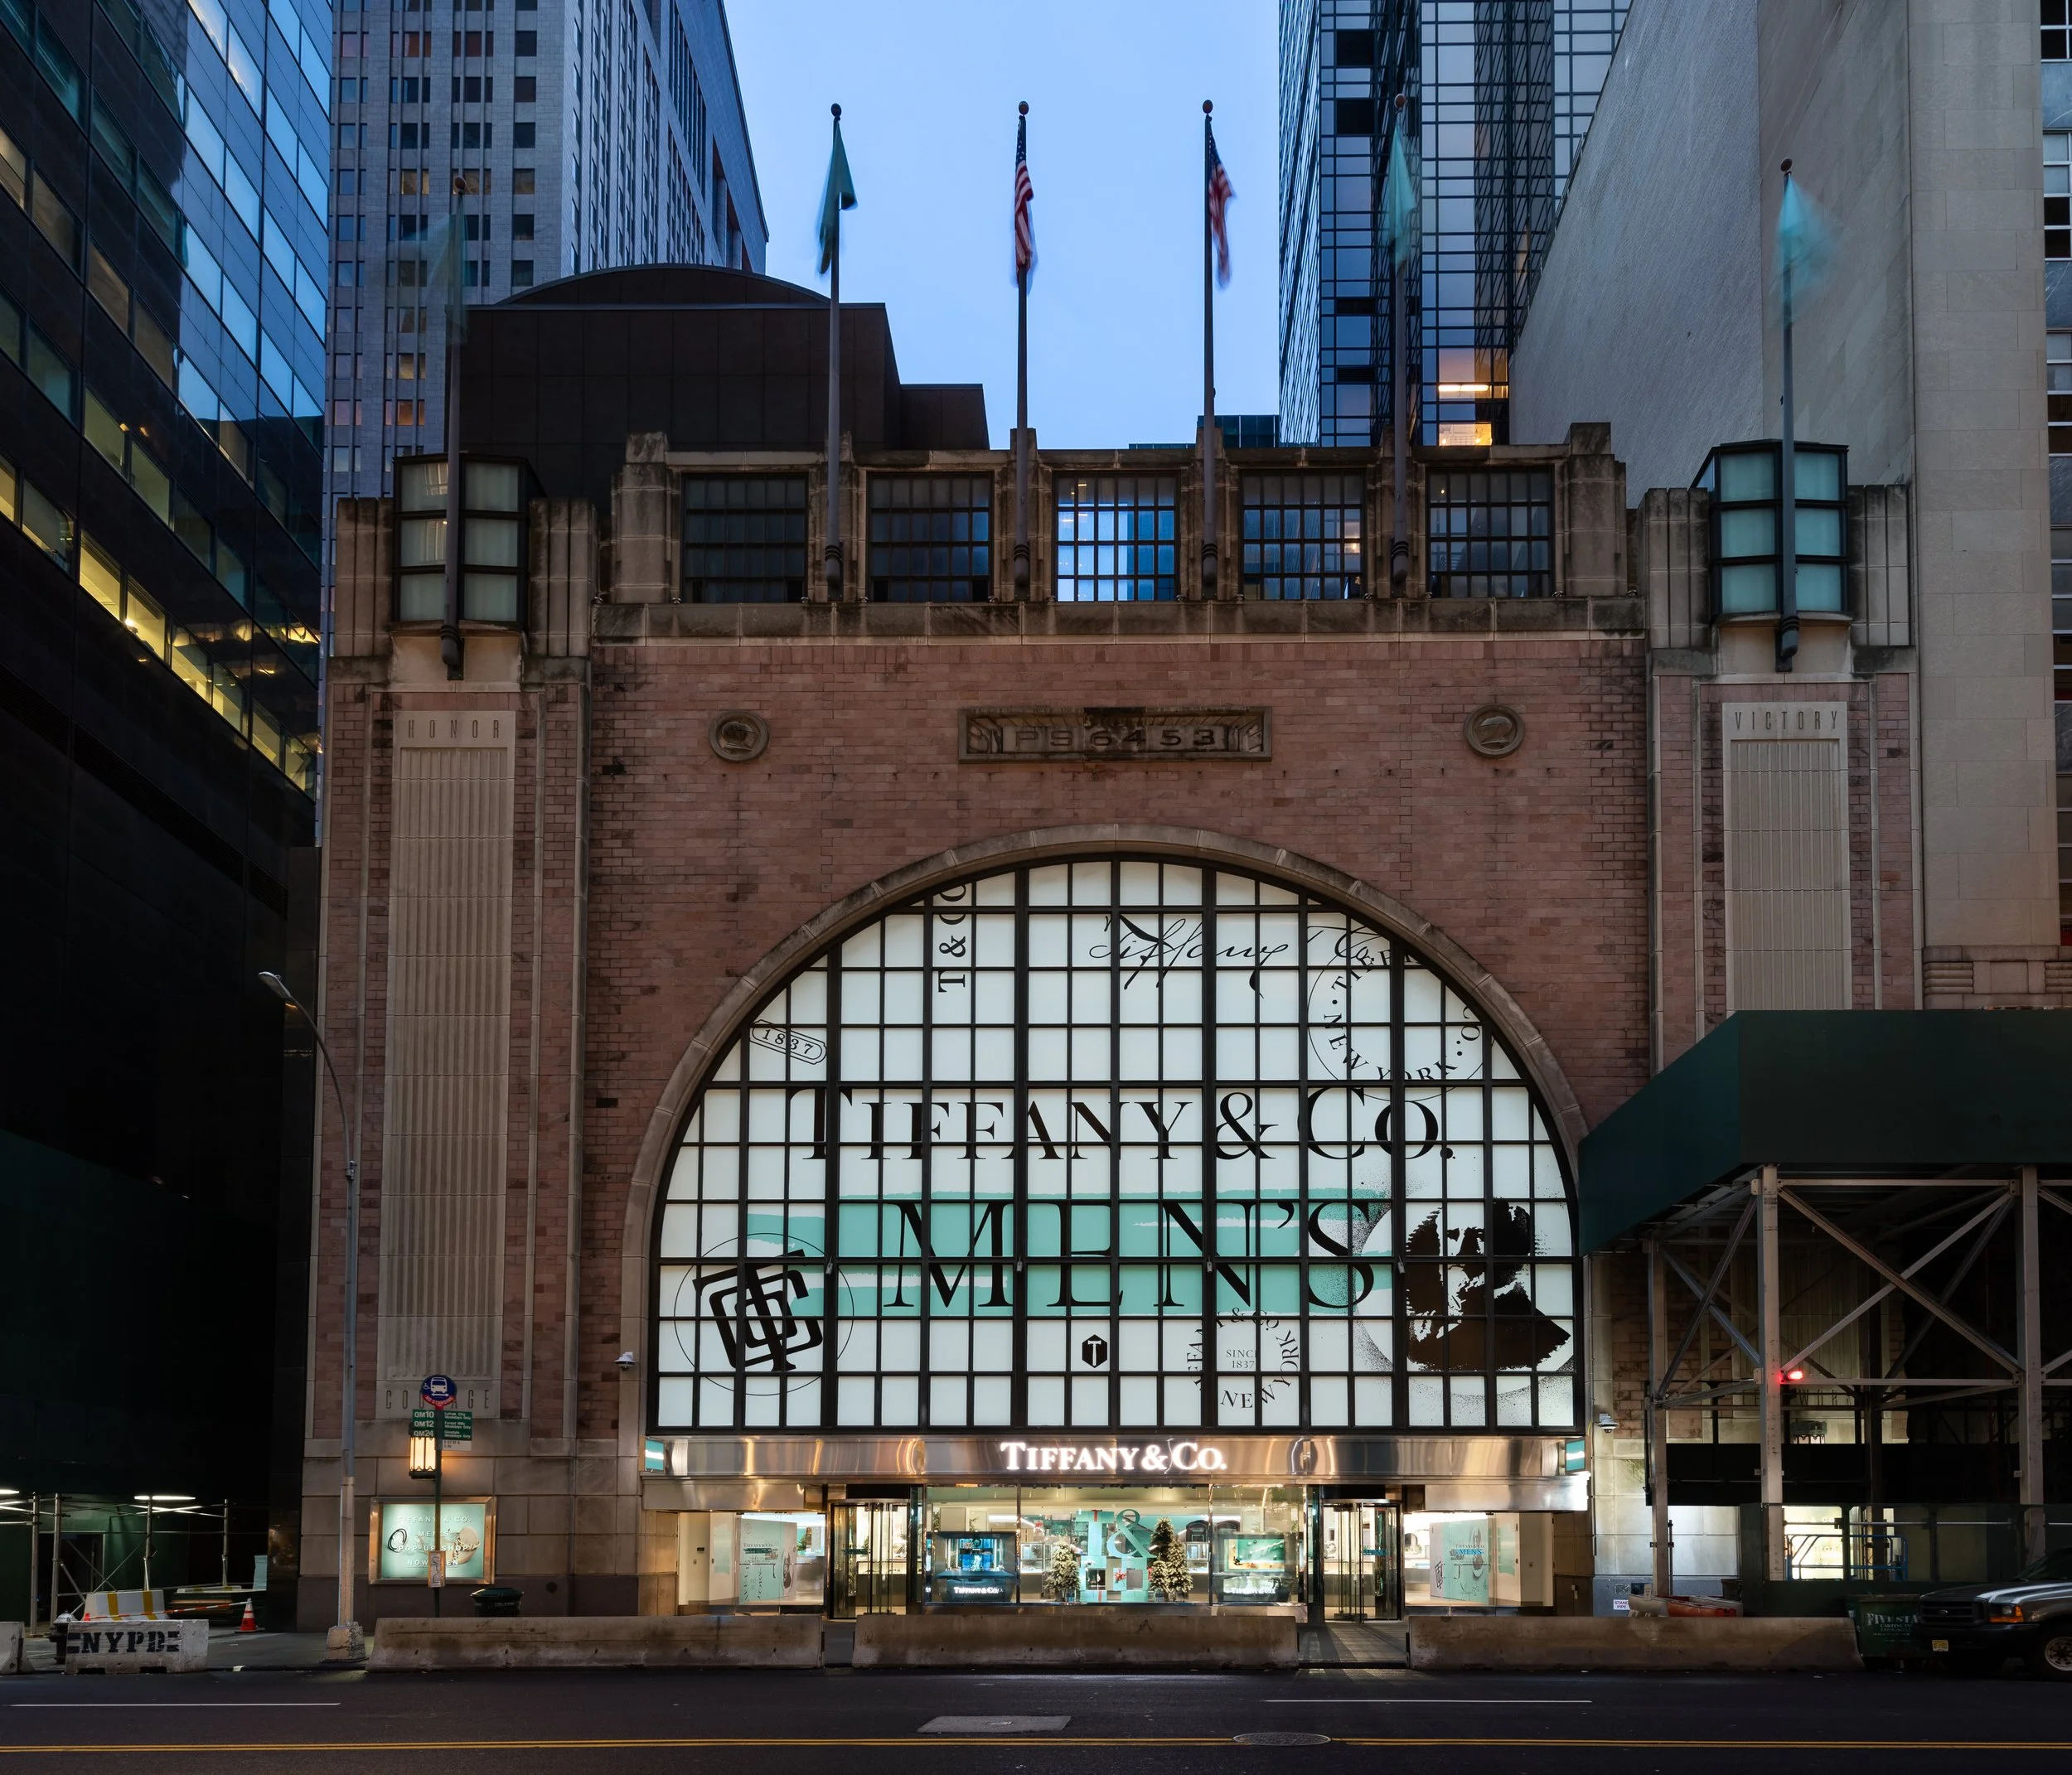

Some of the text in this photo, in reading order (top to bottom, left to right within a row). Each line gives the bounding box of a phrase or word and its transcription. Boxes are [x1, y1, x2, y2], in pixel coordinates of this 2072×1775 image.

[408, 719, 499, 738] HONOR
[1735, 711, 1837, 730] VICTORY
[762, 1028, 814, 1055] 1837
[882, 1199, 1375, 1310] MEN'S
[1226, 1349, 1257, 1358] SINC
[1231, 1360, 1255, 1369] 1837
[1895, 1614, 1918, 1624] STA
[81, 1630, 166, 1653] NYPD
